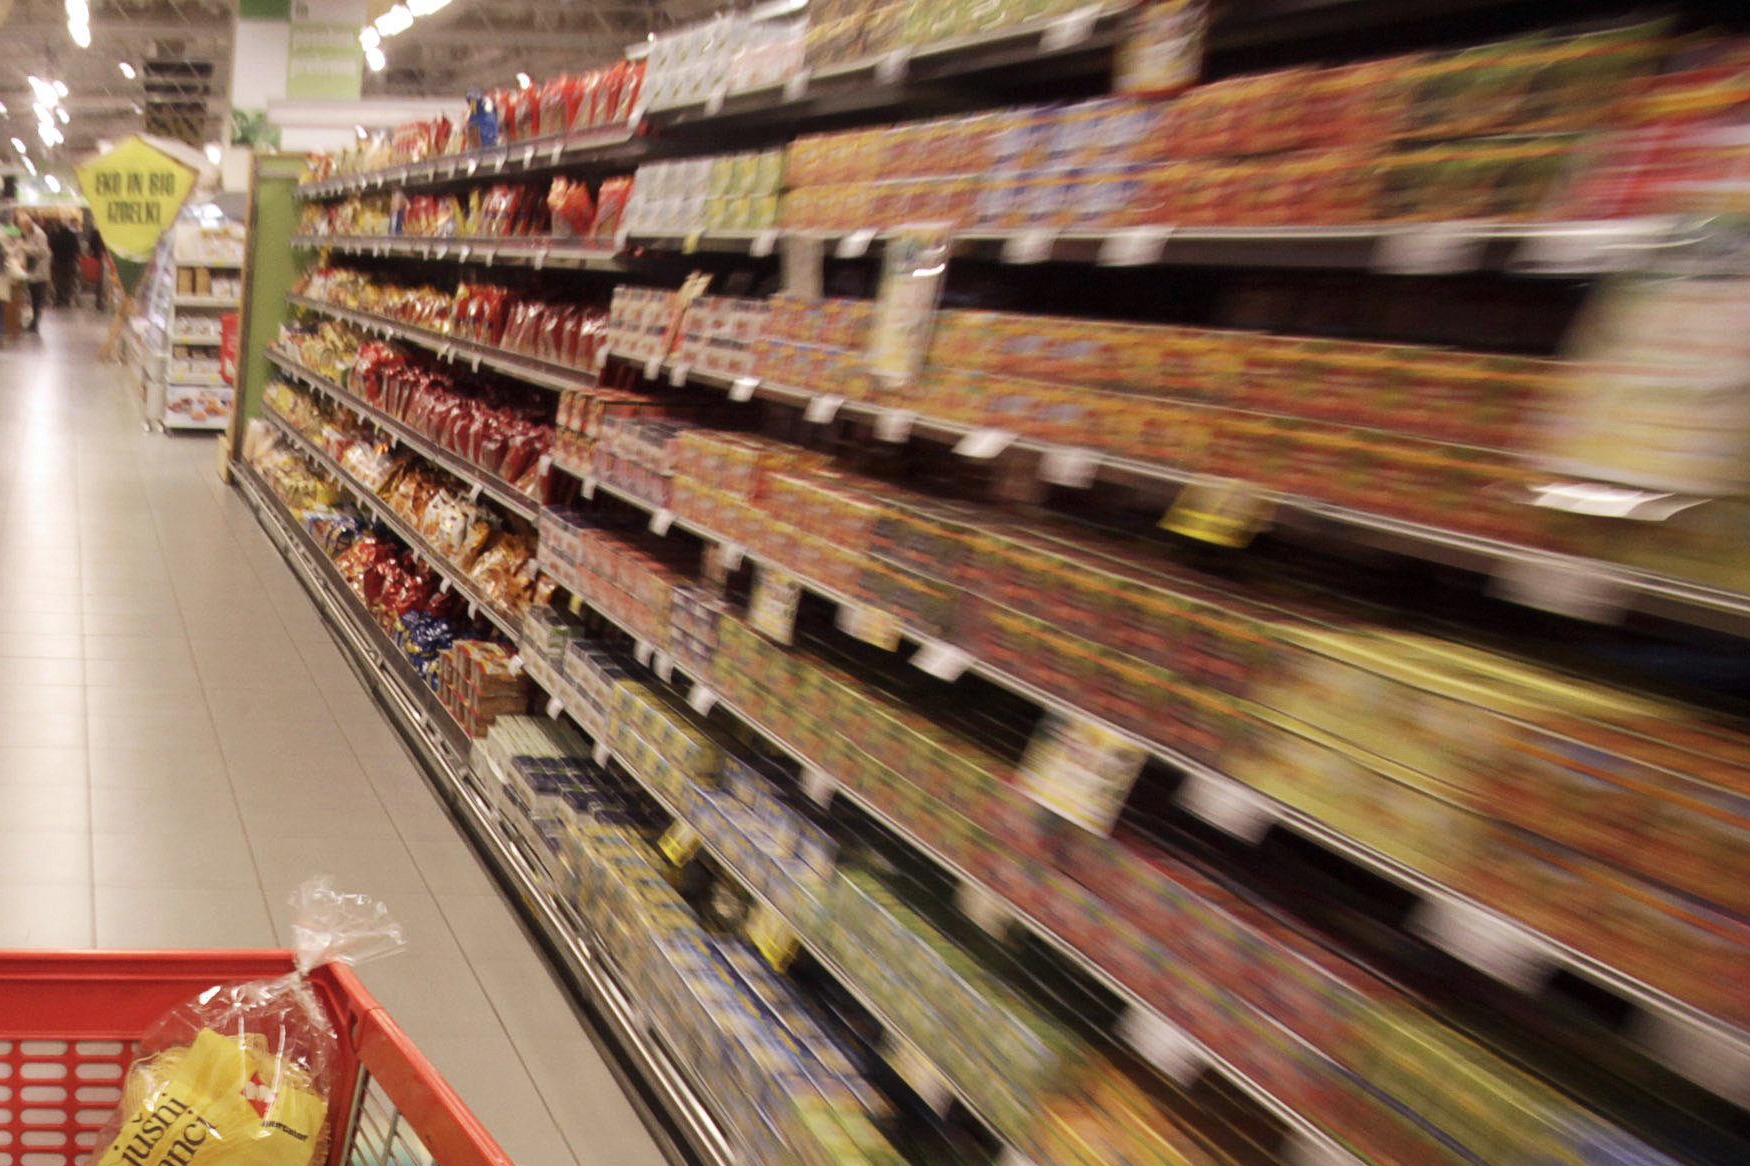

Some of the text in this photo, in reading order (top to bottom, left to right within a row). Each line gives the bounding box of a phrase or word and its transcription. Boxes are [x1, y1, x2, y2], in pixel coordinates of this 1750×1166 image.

[95, 171, 175, 196] EKO IN BIO
[107, 201, 161, 224] IZDELKI
